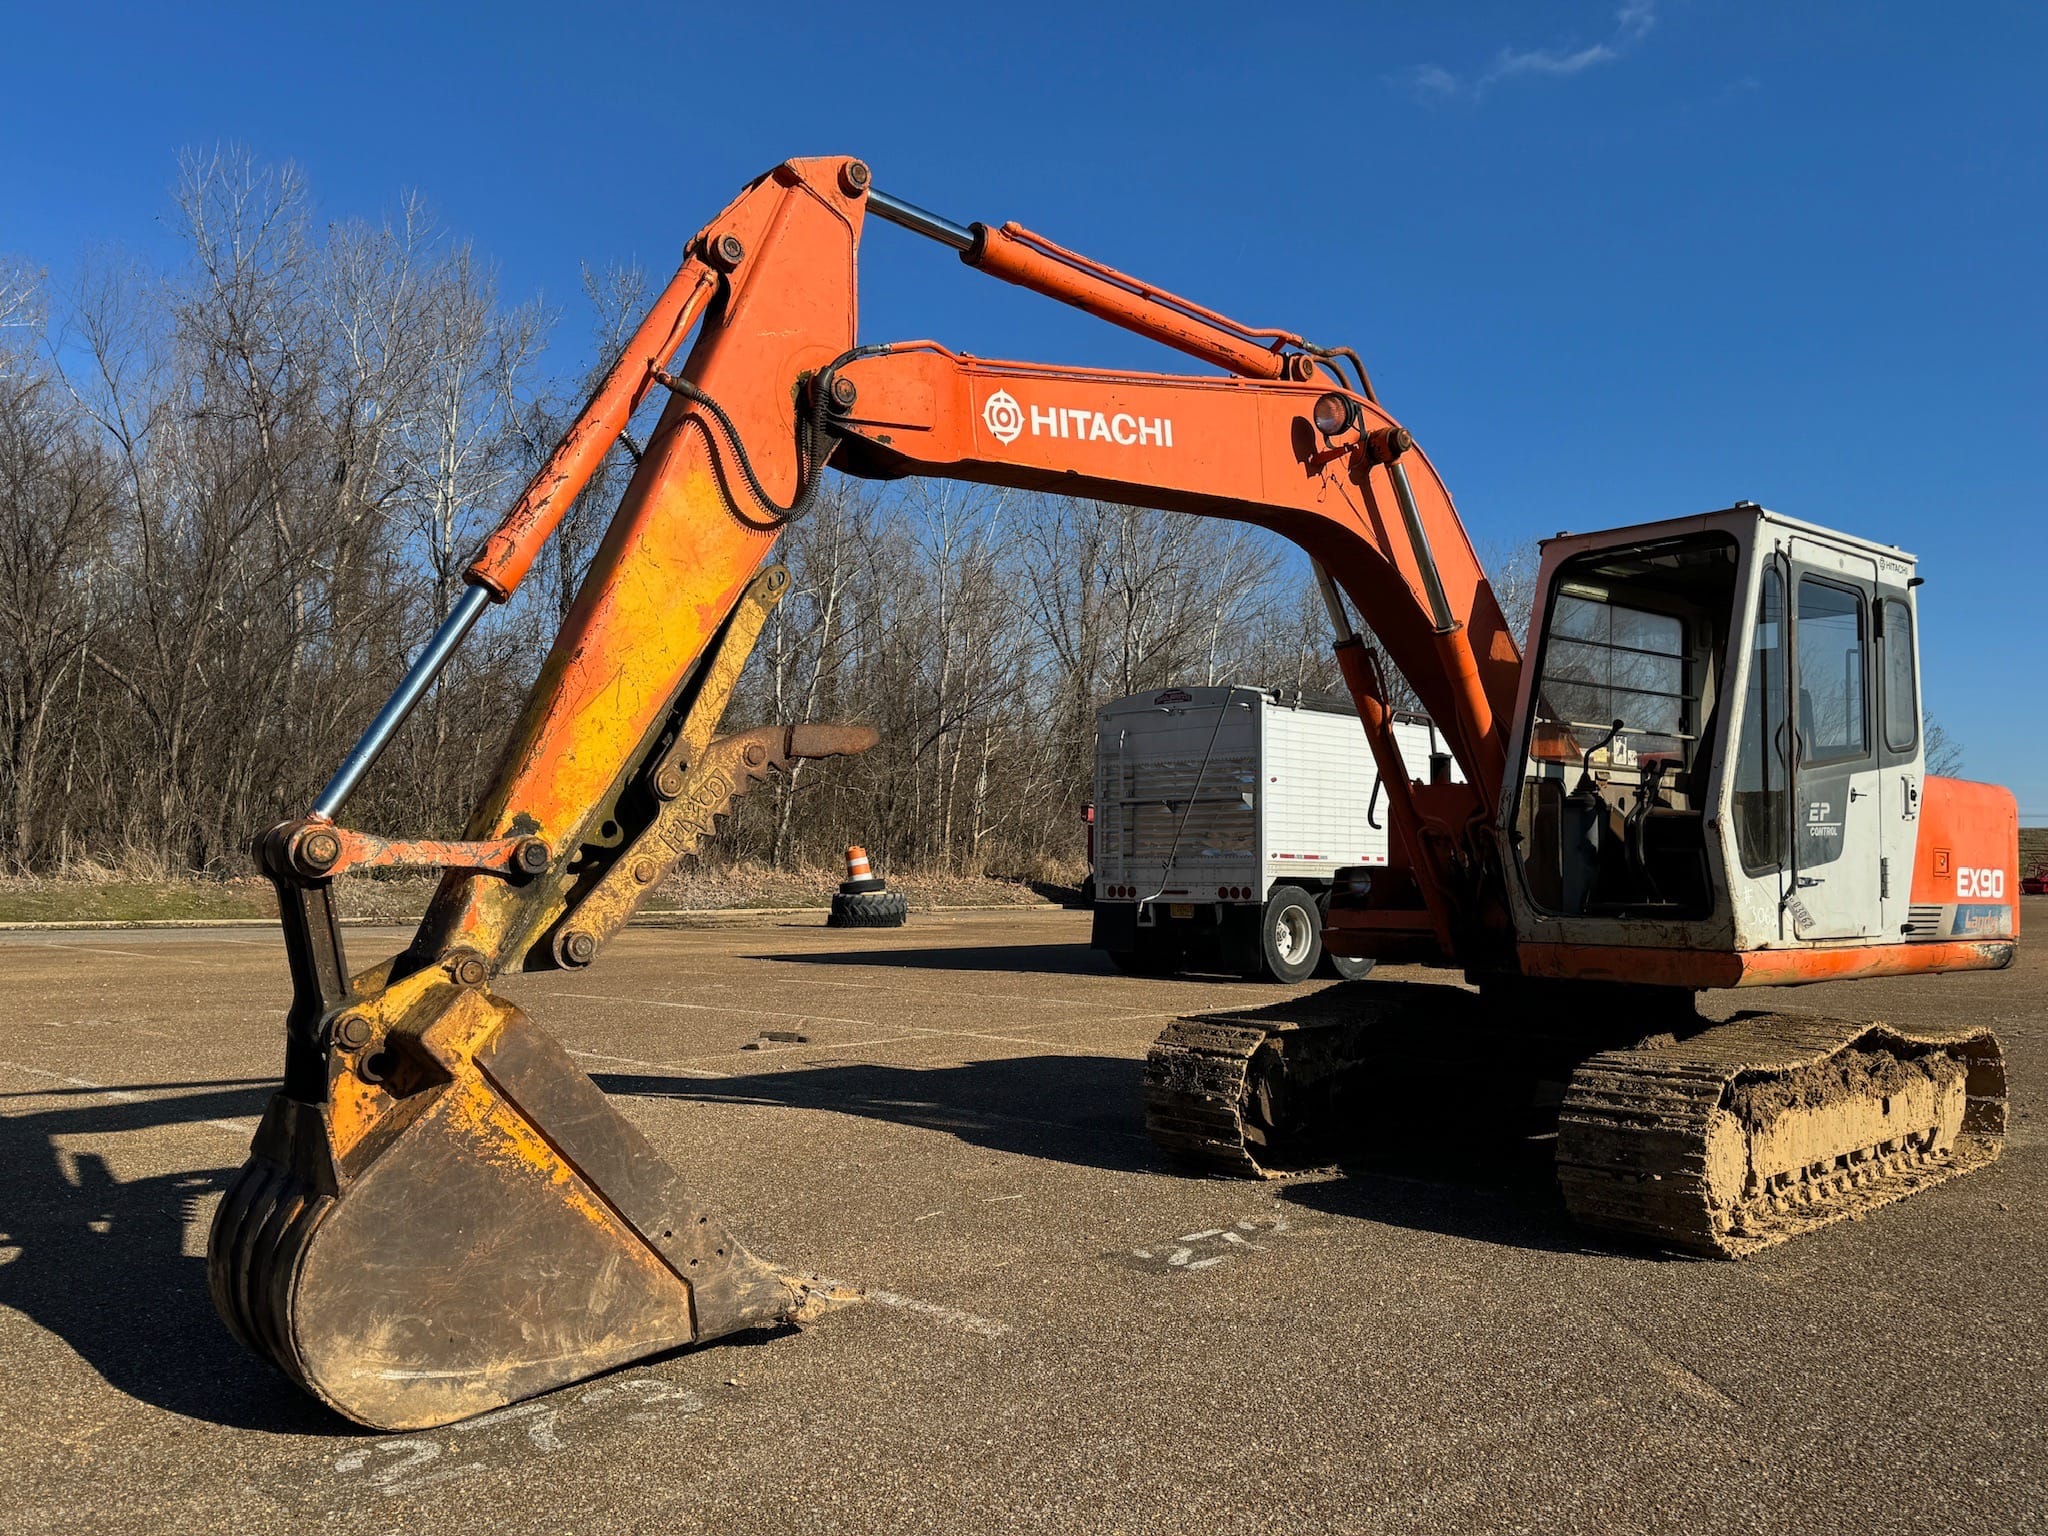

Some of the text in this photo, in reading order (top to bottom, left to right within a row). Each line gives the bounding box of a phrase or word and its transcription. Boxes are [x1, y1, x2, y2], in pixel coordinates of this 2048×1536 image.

[1030, 405, 1173, 448] HITACHI
[1809, 802, 1831, 821] EP
[1810, 826, 1838, 837] CONTROL
[1956, 866, 2004, 899] EX90
[1792, 900, 1814, 929] 03062
